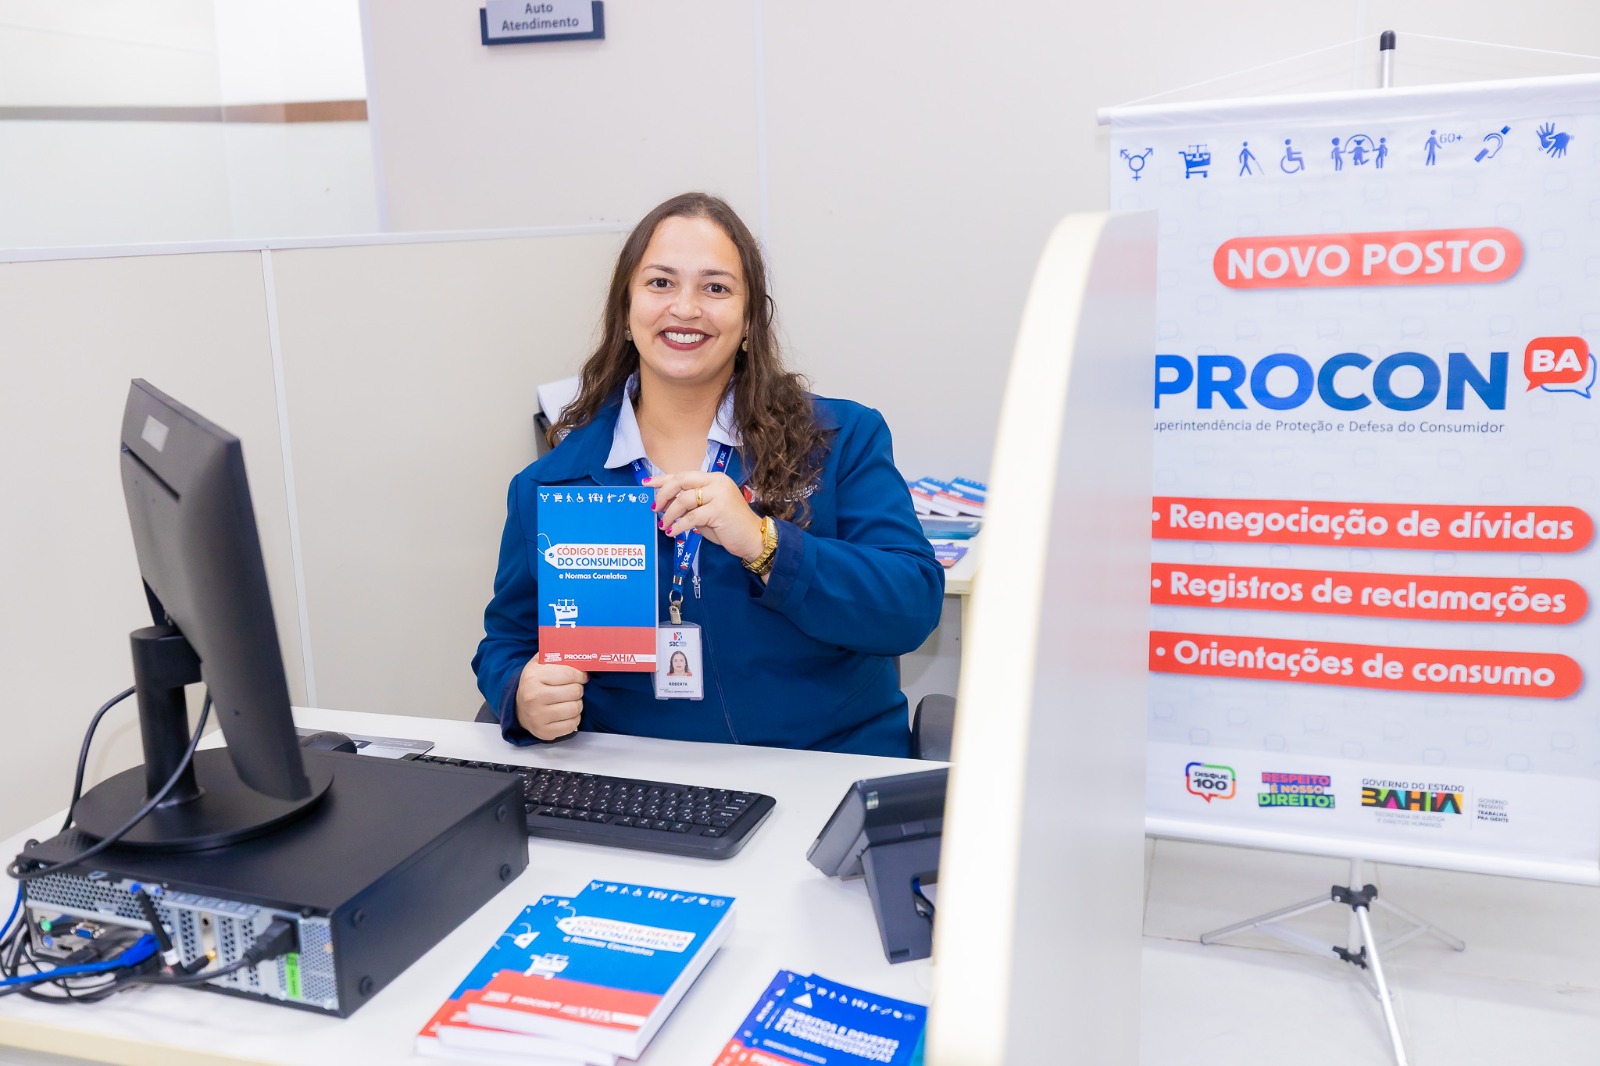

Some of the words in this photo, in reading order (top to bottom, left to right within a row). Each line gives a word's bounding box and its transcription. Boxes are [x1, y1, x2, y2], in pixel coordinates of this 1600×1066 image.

[525, 3, 553, 14] Auto
[502, 17, 579, 31] Atendimento
[1227, 245, 1350, 280] NOVO
[1362, 239, 1506, 276] POSTO
[1154, 352, 1510, 412] PROCON
[1531, 349, 1583, 373] BA
[1256, 420, 1272, 431] de
[1276, 420, 1333, 434] Proteção
[1337, 423, 1345, 431] e
[1350, 421, 1394, 432] Defesa
[1398, 421, 1416, 433] do
[1420, 421, 1505, 433] Consumidor
[1169, 504, 1388, 540] Renegociação
[1397, 511, 1440, 537] de
[1449, 511, 1574, 540] dívidas
[557, 545, 595, 556] CÓDIGO
[597, 548, 609, 556] DE
[611, 547, 643, 556] DEFESA
[557, 558, 573, 567] DO
[576, 558, 644, 567] CONSUMIDOR
[1170, 571, 1303, 603] Registros
[1311, 577, 1353, 605] de
[1361, 583, 1566, 617] reclamações
[1174, 640, 1354, 678] Orientações
[1362, 653, 1404, 680] de
[1412, 662, 1555, 687] consumo
[1194, 771, 1229, 779] DISQUE
[1262, 773, 1330, 785] RESPEITO
[1193, 778, 1228, 791] 100
[1281, 785, 1324, 794] NOSSO
[1362, 778, 1409, 789] GOVERNO
[1411, 782, 1425, 790] DO
[1428, 783, 1465, 793] ESTADO
[1259, 793, 1335, 808] DIREITO!
[1361, 787, 1463, 814] BAHIA
